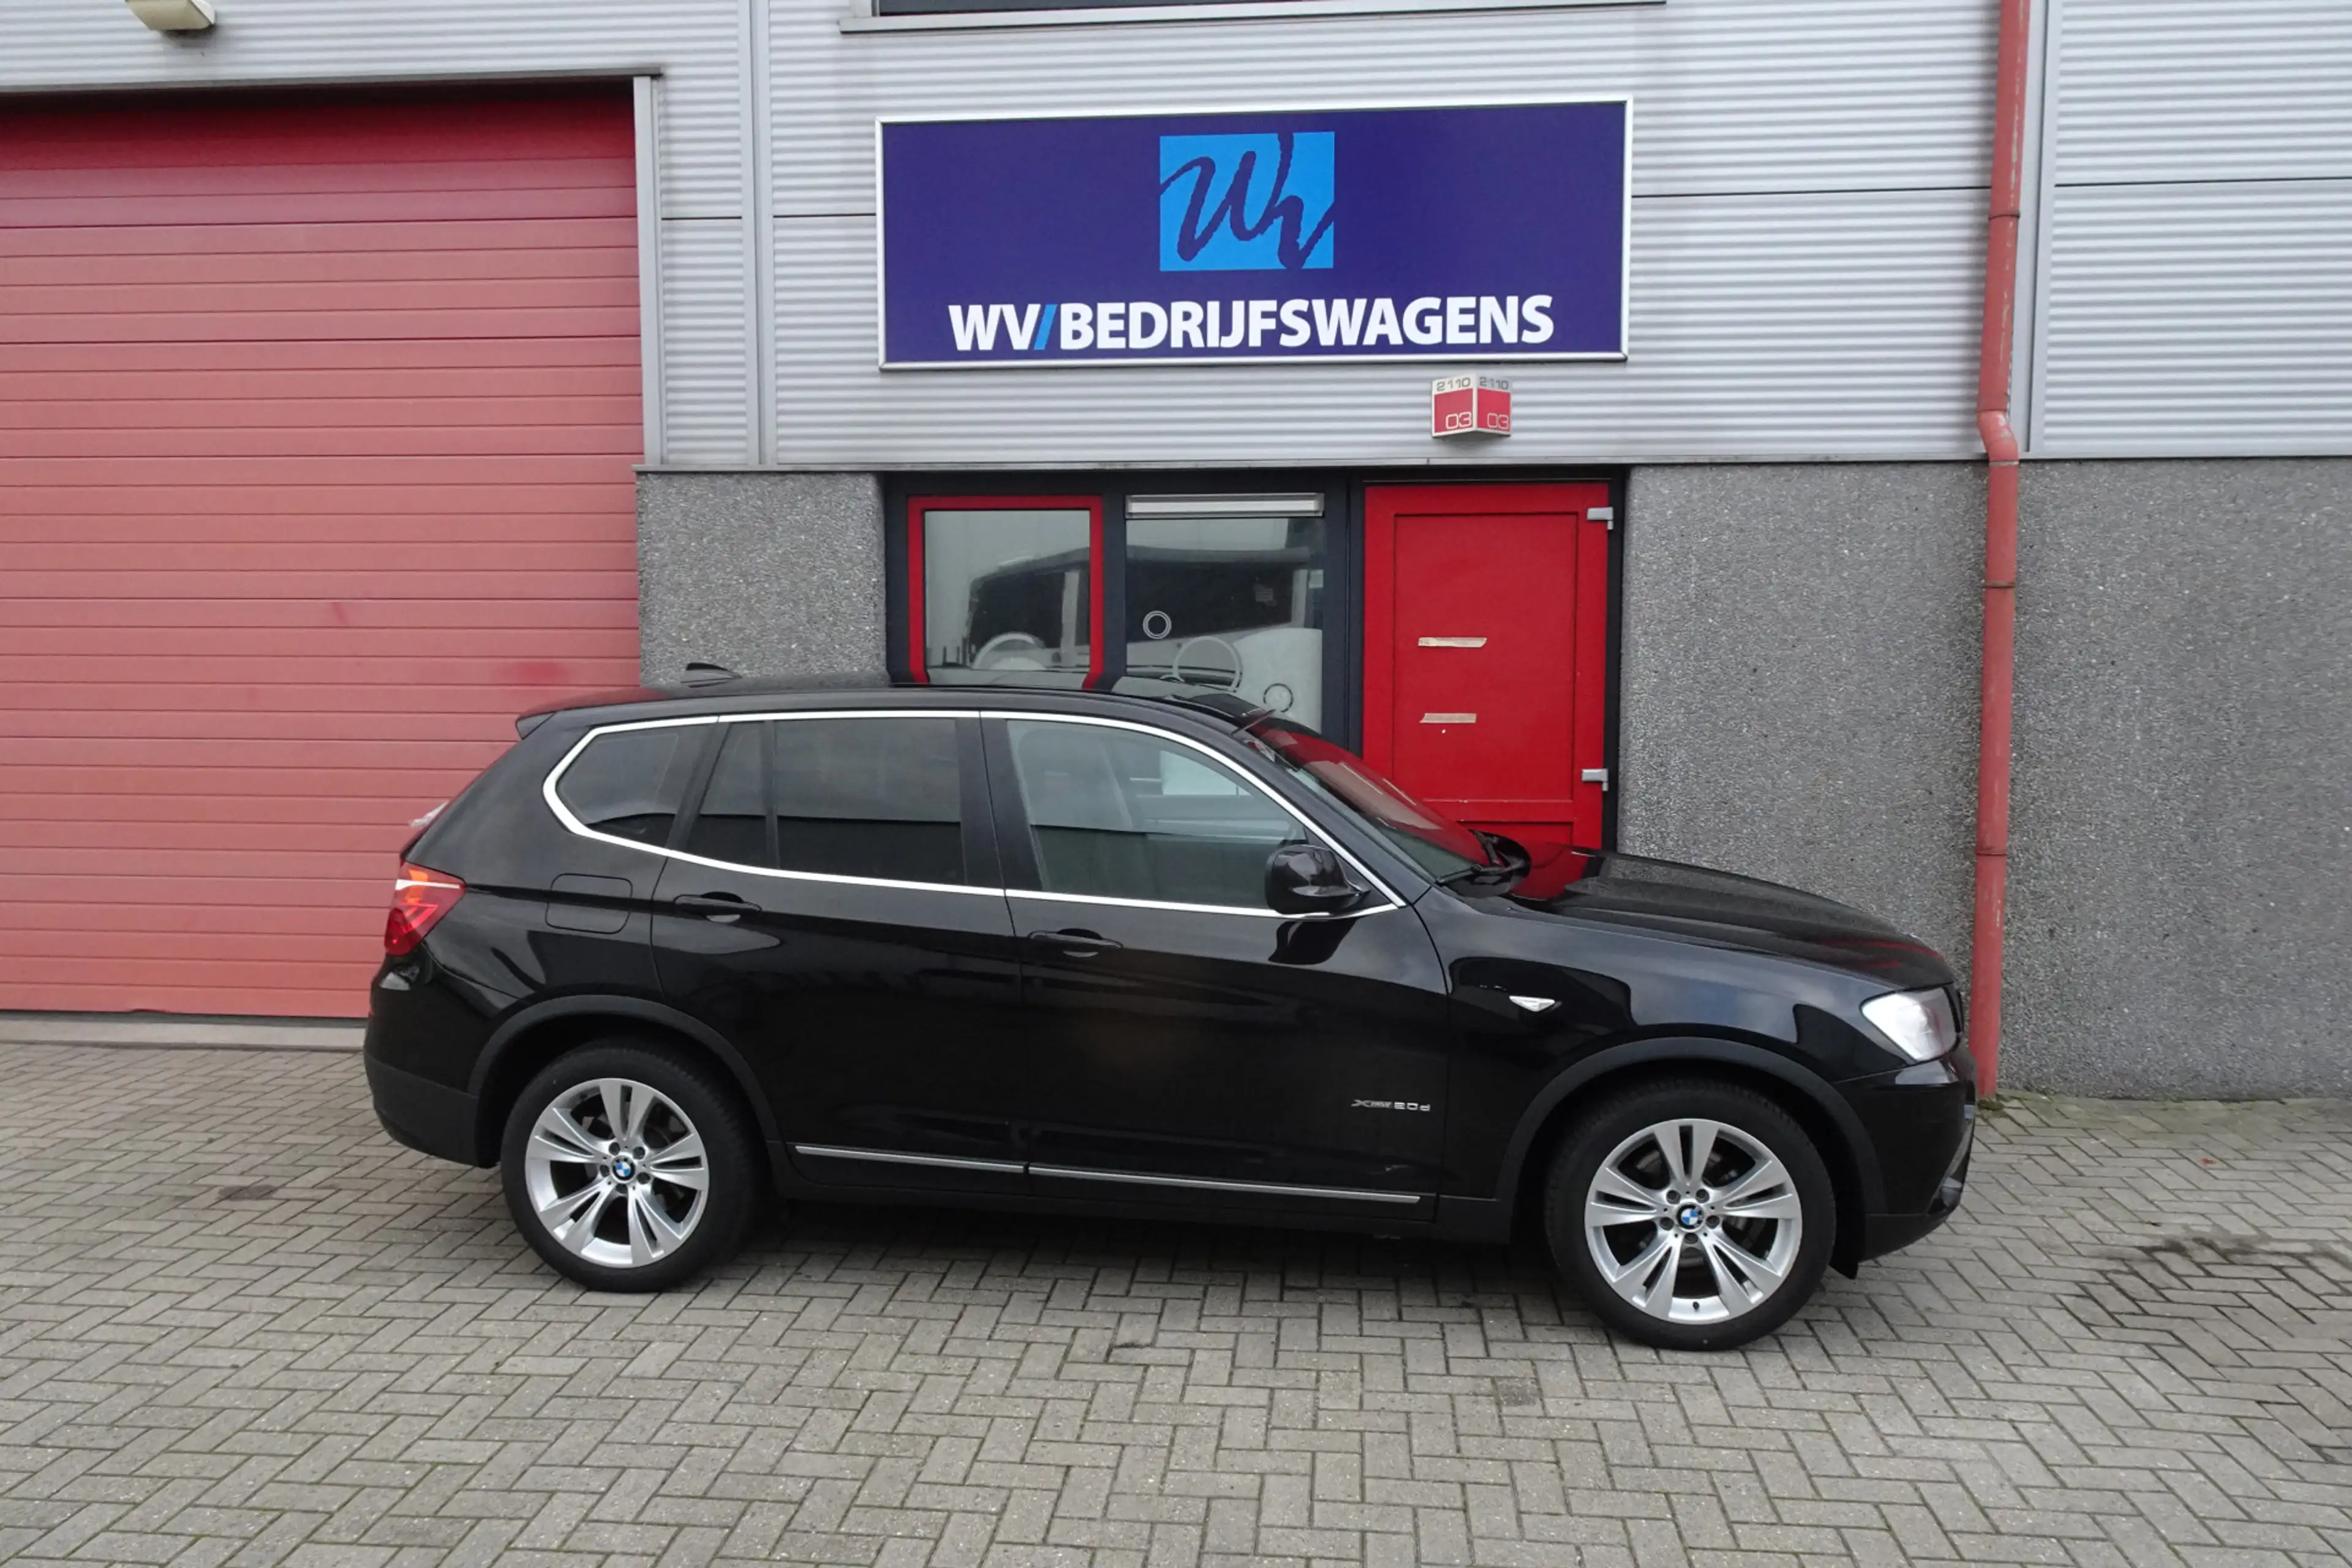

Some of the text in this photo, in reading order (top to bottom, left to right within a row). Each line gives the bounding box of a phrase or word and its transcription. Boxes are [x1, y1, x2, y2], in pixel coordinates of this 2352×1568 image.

[1436, 377, 1471, 391] 2110
[1479, 377, 1509, 390] 2110
[1446, 412, 1472, 430] 03
[1487, 413, 1509, 430] 03
